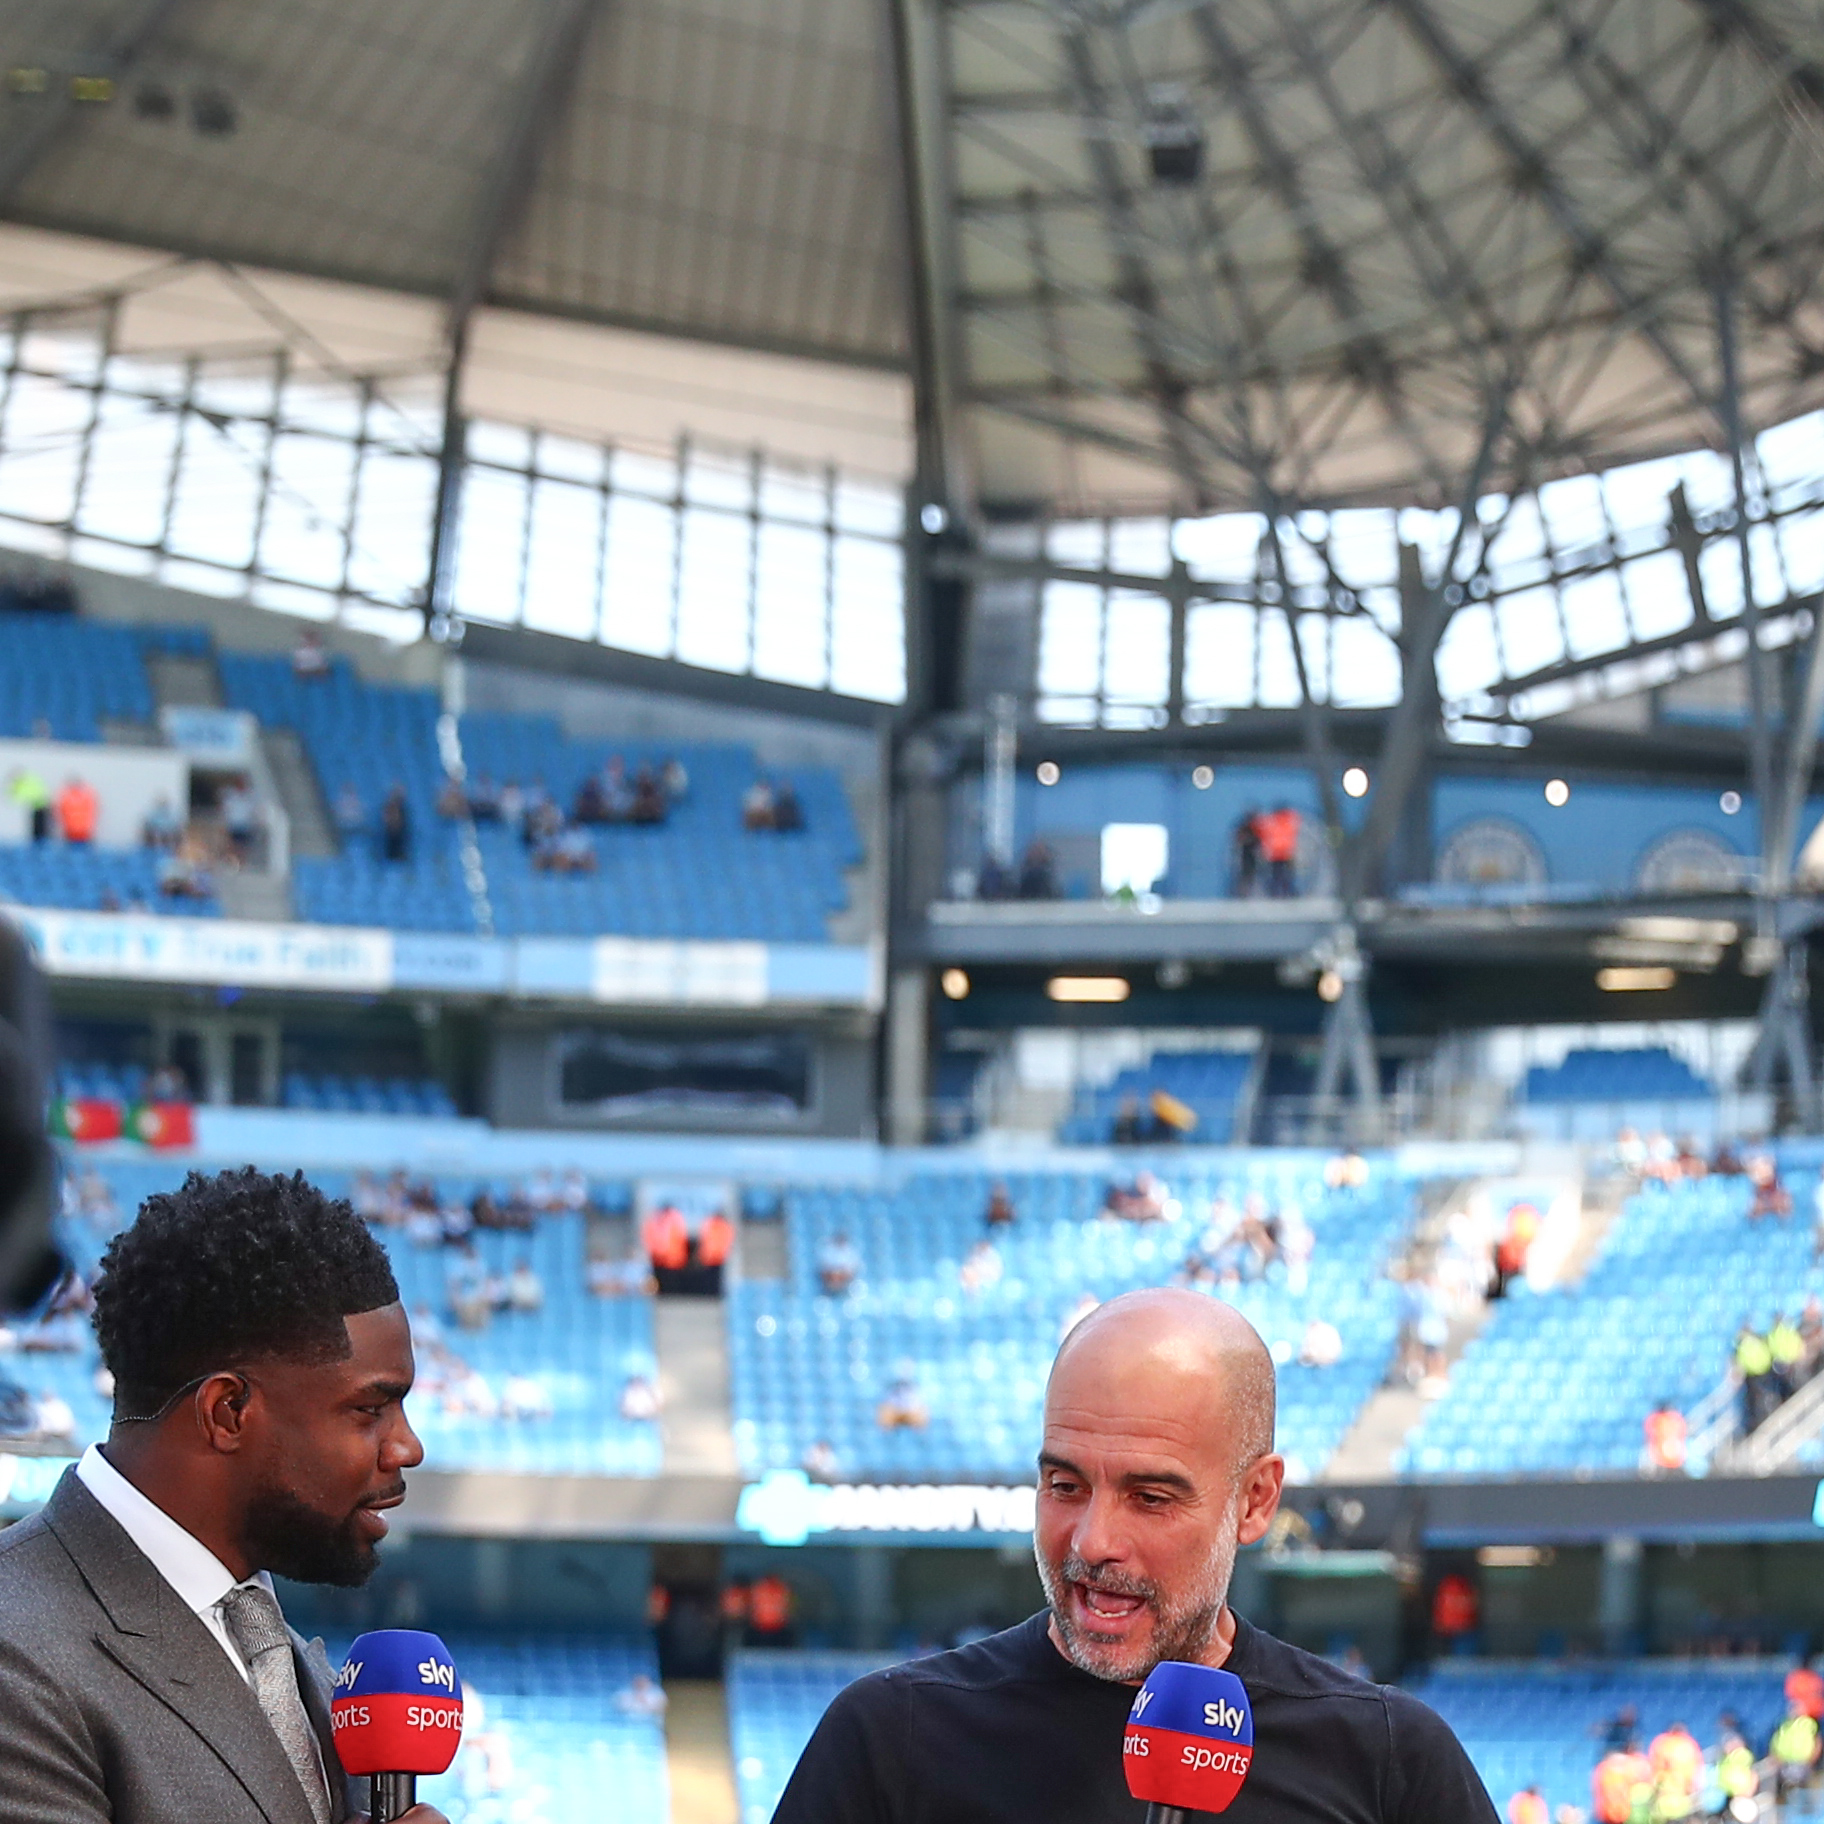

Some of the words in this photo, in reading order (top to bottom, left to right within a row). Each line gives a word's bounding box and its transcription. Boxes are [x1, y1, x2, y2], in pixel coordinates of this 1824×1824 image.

[418, 1656, 454, 1693] sky
[1131, 1683, 1155, 1718] ky
[1203, 1698, 1245, 1736] sky
[331, 1704, 371, 1737] ports
[1123, 1733, 1150, 1757] orts
[1180, 1746, 1249, 1775] sports
